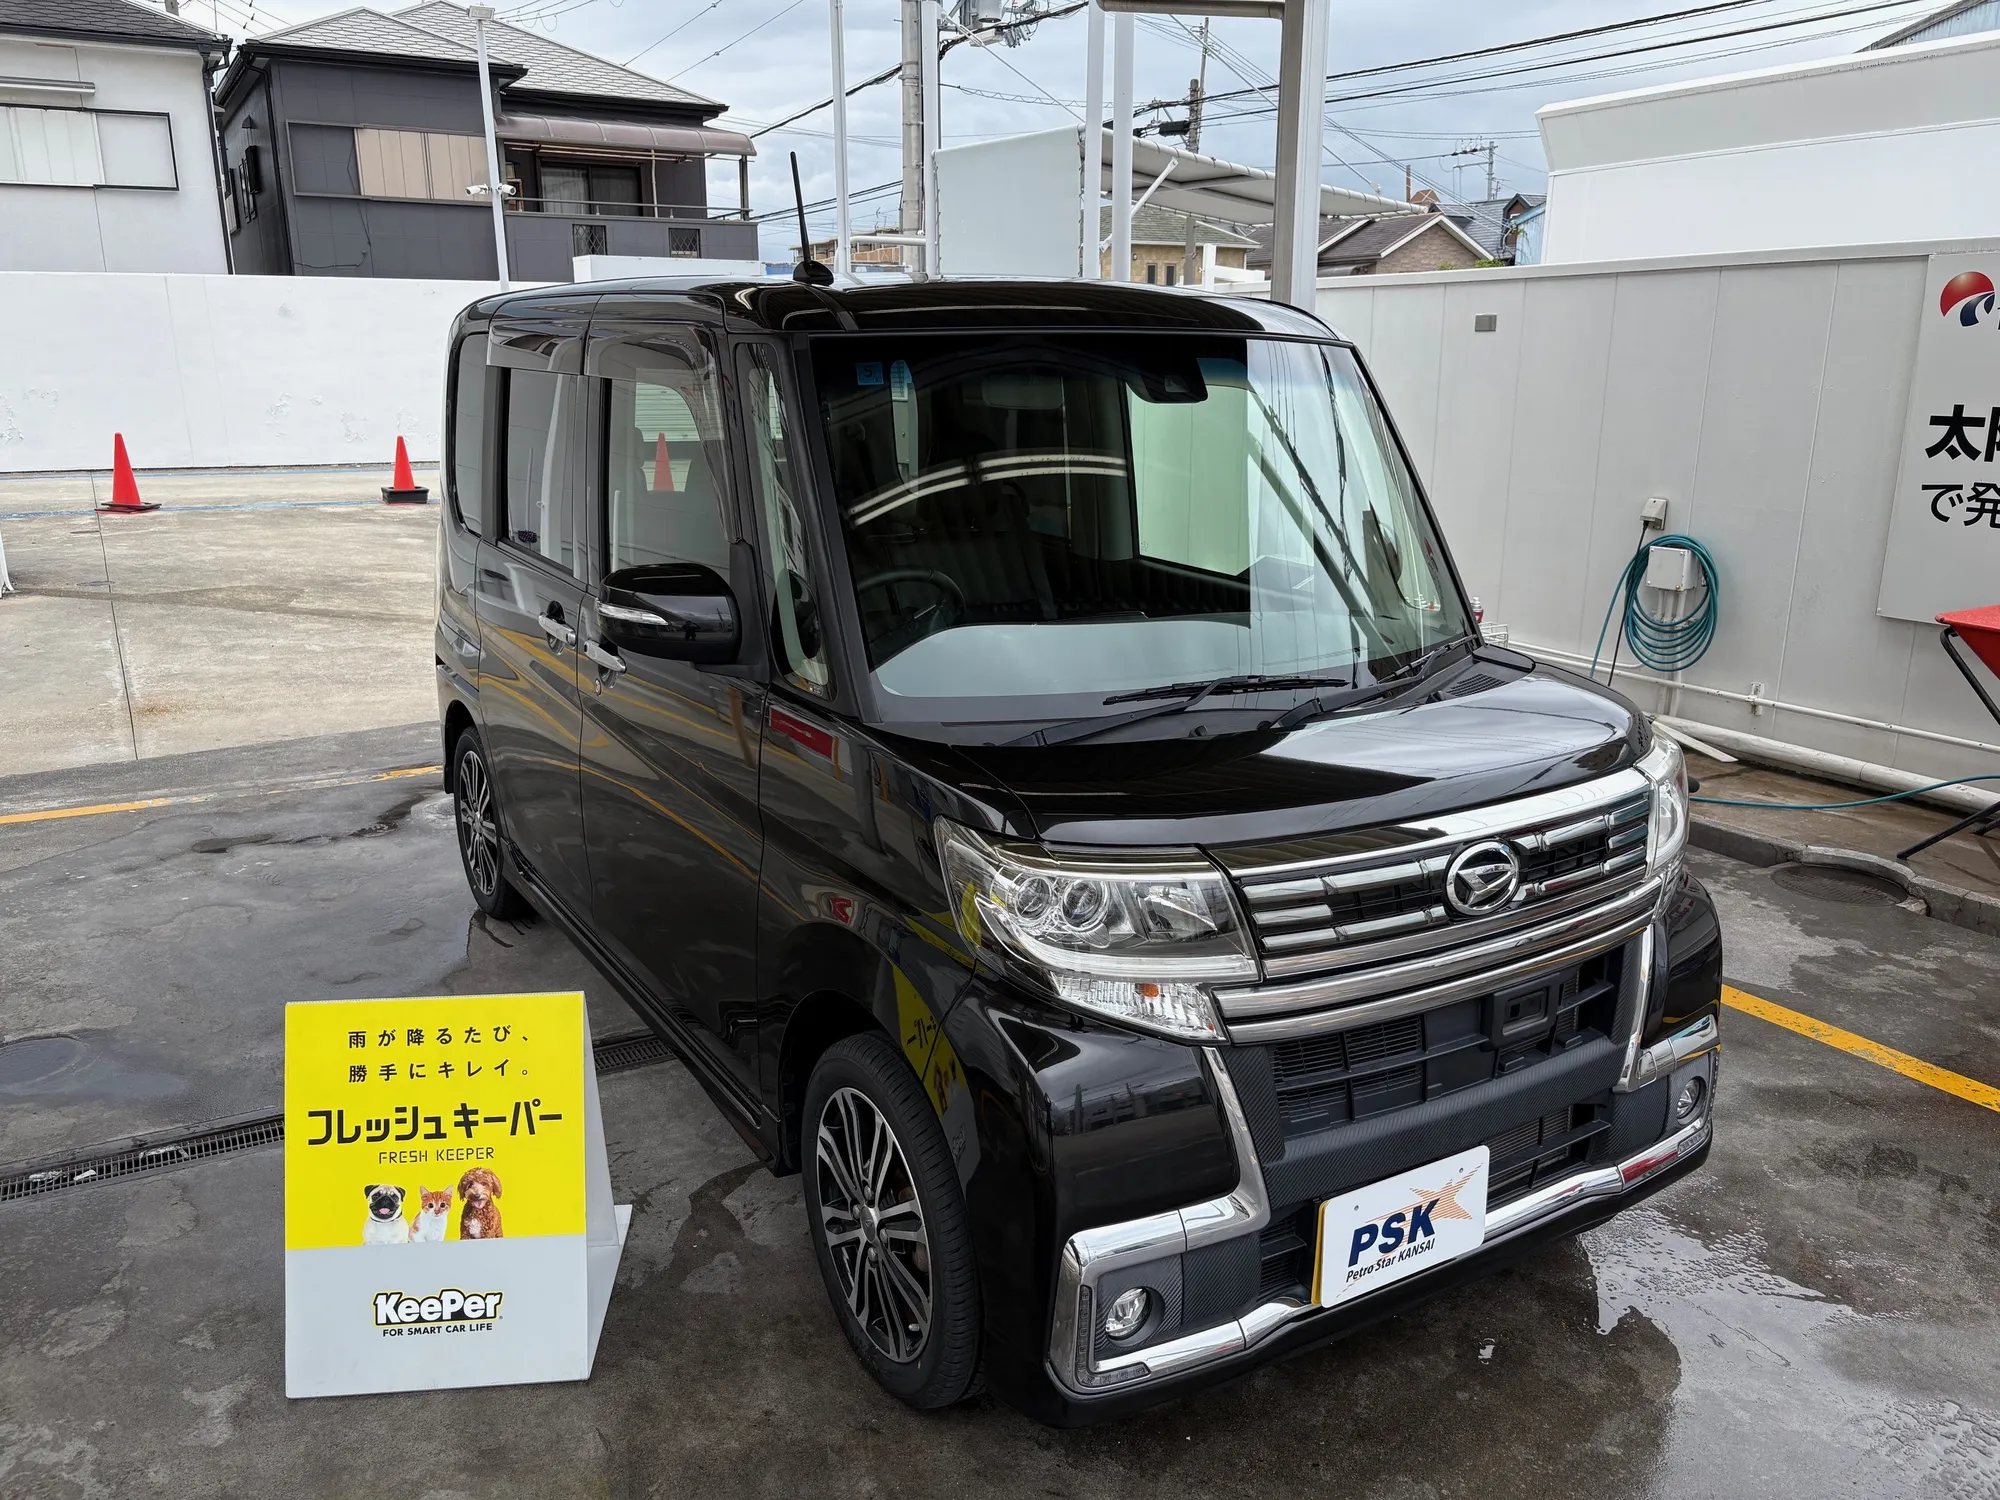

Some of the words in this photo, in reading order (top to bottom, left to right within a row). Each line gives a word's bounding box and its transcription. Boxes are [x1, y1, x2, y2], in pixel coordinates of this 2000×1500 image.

[348, 1025, 529, 1049] 雨が降るたび、
[348, 1058, 528, 1083] 勝手にキレイ。
[307, 1098, 563, 1146] フレッシュキーパー
[378, 1150, 428, 1165] FRESH
[436, 1146, 495, 1162] KEEPER
[1347, 1198, 1440, 1267] PSK
[1346, 1263, 1375, 1283] Petro
[1375, 1254, 1396, 1272] Star
[1398, 1238, 1436, 1263] KANSAI
[374, 1288, 503, 1326] KeePer
[382, 1328, 404, 1337] FOR
[407, 1325, 442, 1336] SMART
[446, 1324, 466, 1333] CAR
[469, 1322, 493, 1332] LIFE
